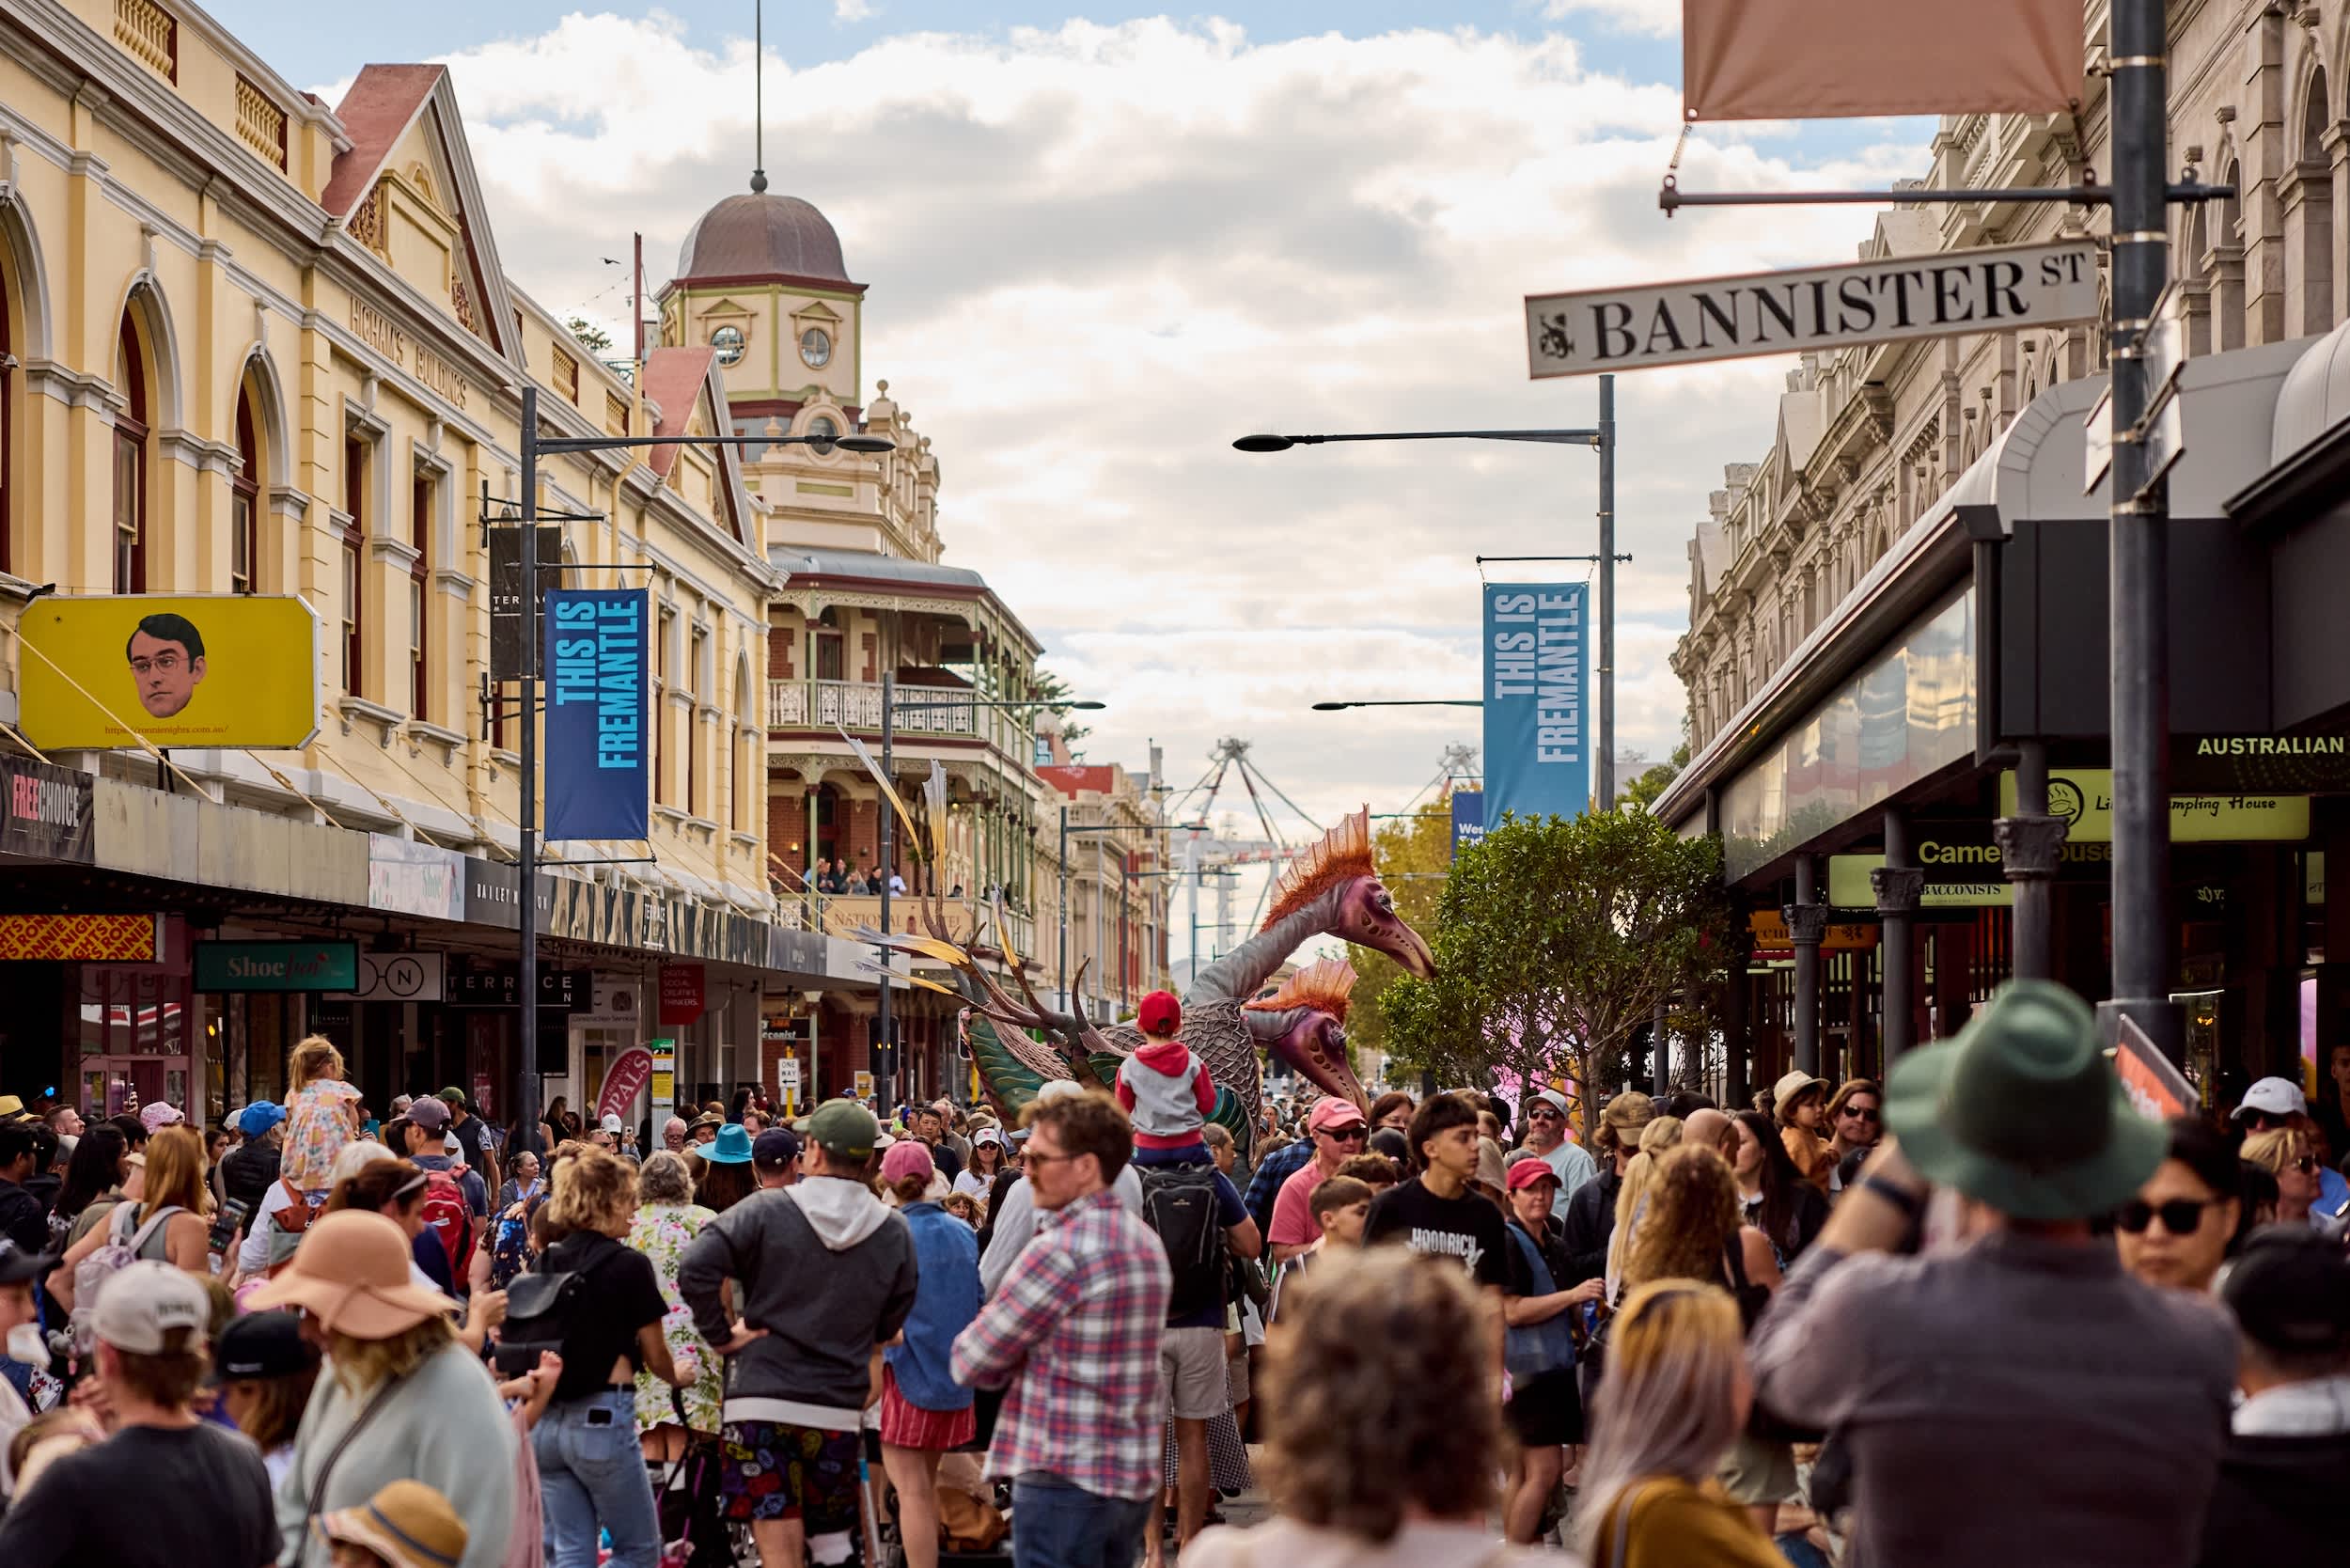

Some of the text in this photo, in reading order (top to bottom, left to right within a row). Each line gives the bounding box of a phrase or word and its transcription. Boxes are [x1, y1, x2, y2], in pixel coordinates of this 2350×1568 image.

[1589, 251, 2086, 361] BANNISTER ST
[556, 601, 596, 705] THIS IS
[598, 600, 638, 768] FREMANTLE
[1495, 594, 1536, 699] THIS IS
[1538, 593, 1579, 762] FREMANTLE
[2198, 736, 2344, 755] AUSTRALIAN
[2228, 797, 2276, 809] House
[447, 976, 572, 989] TERRCE
[1412, 1227, 1477, 1257] HOODRICH
